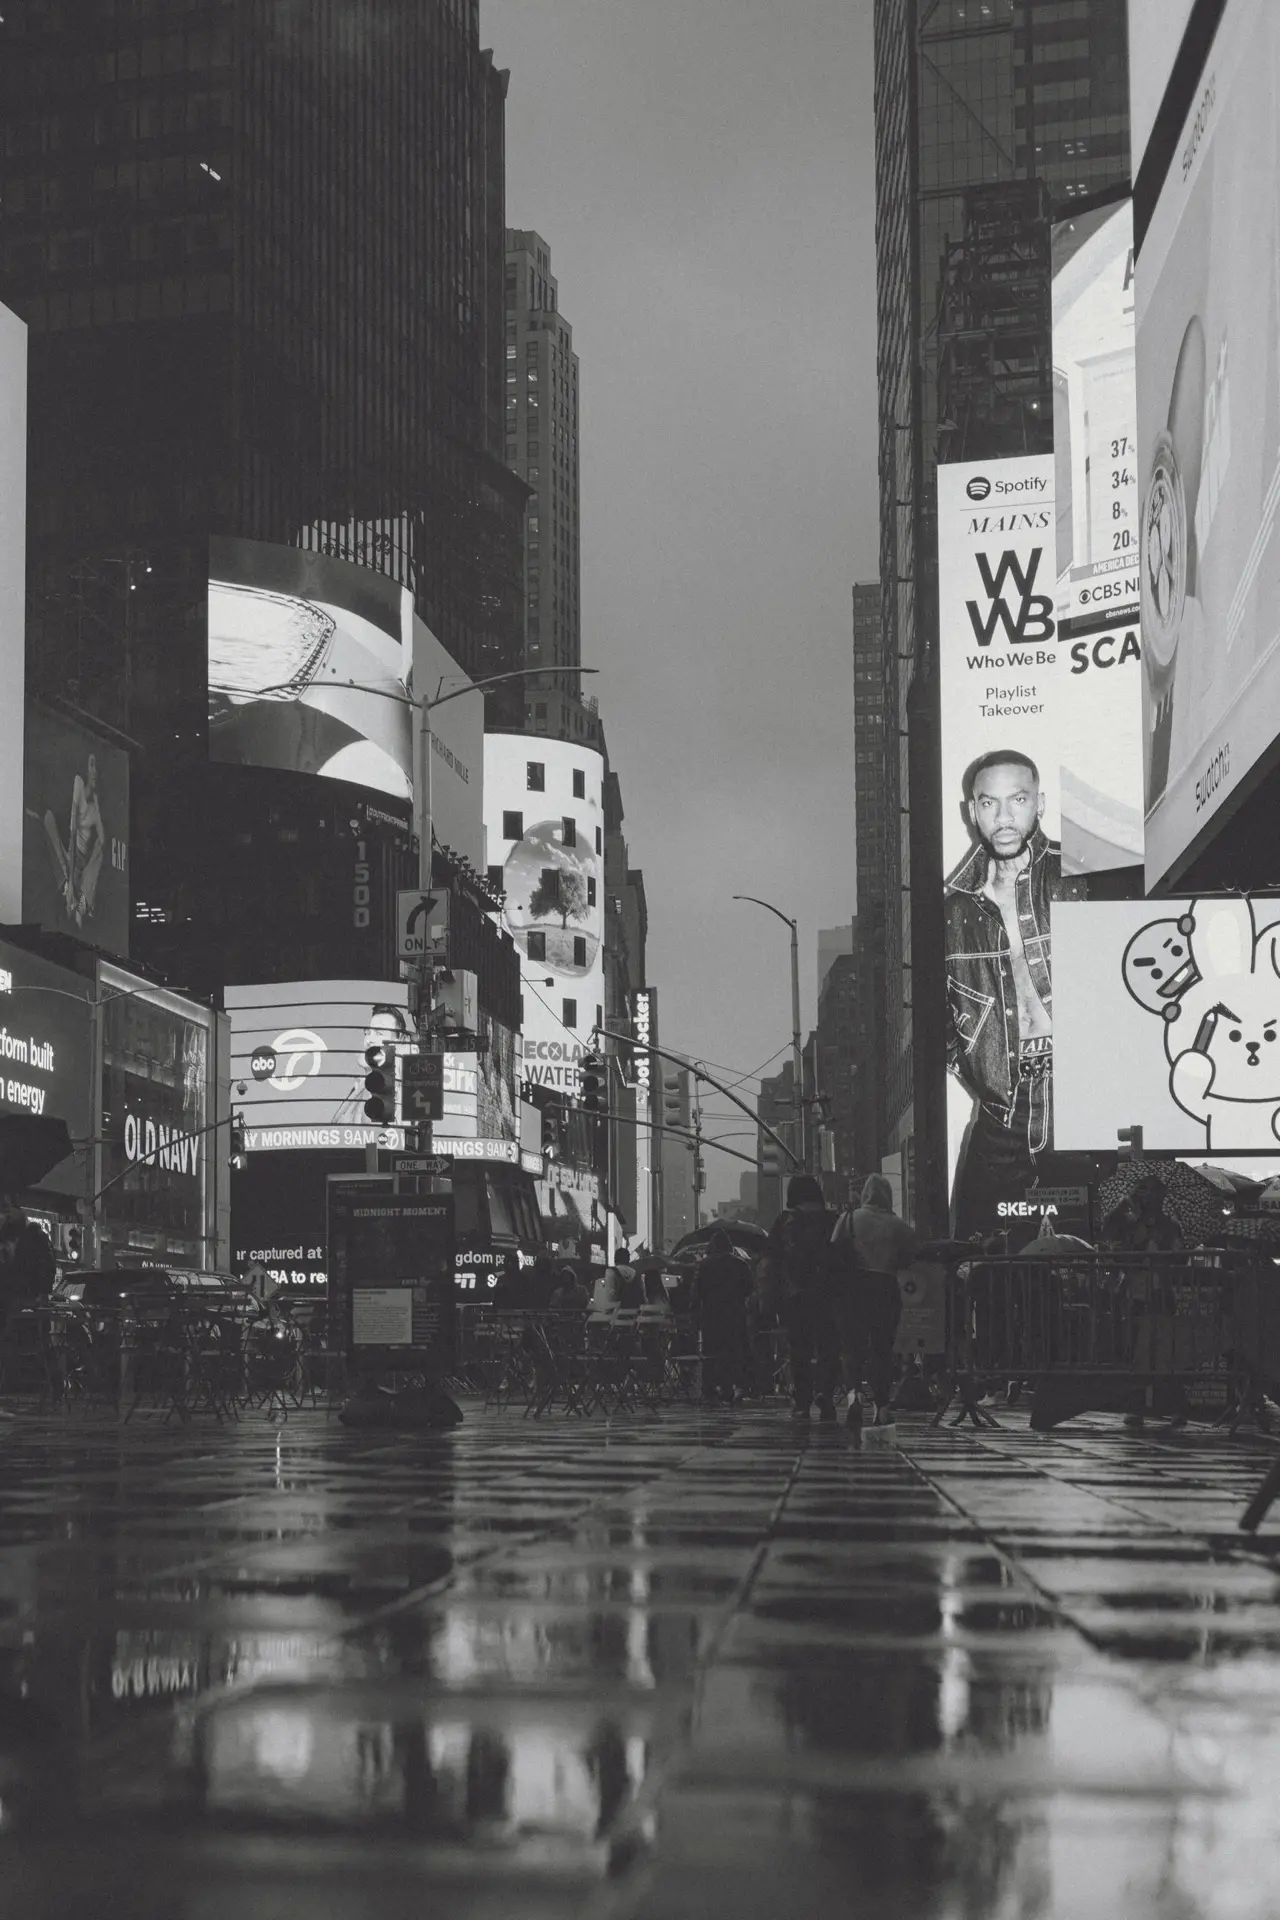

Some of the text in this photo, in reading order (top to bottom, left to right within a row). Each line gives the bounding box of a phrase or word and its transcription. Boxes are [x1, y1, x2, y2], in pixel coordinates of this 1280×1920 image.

[995, 477, 1047, 494] Spotify
[967, 511, 1051, 535] MAINS
[1093, 557, 1125, 575] AMERICA
[1092, 581, 1122, 601] CBS
[966, 651, 1056, 669] Who We Be
[986, 685, 1037, 701] Playlist
[979, 703, 1044, 717] Takeover
[1195, 746, 1225, 813] swatch
[404, 938, 440, 951] ONLY
[30, 1037, 54, 1072] built
[252, 1056, 274, 1071] abc
[7, 1079, 46, 1116] energy
[124, 1114, 199, 1176] OLD NAVY
[261, 1129, 340, 1147] MORNINGS
[344, 1129, 375, 1145] 9AM
[486, 1142, 507, 1157] 9AM
[400, 1160, 444, 1170] ONE WAY
[352, 1206, 448, 1217] MIDNIGHT MOMENT
[250, 1246, 303, 1262] captured
[307, 1247, 323, 1259] at
[455, 1250, 493, 1267] gdom
[291, 1271, 305, 1284] to
